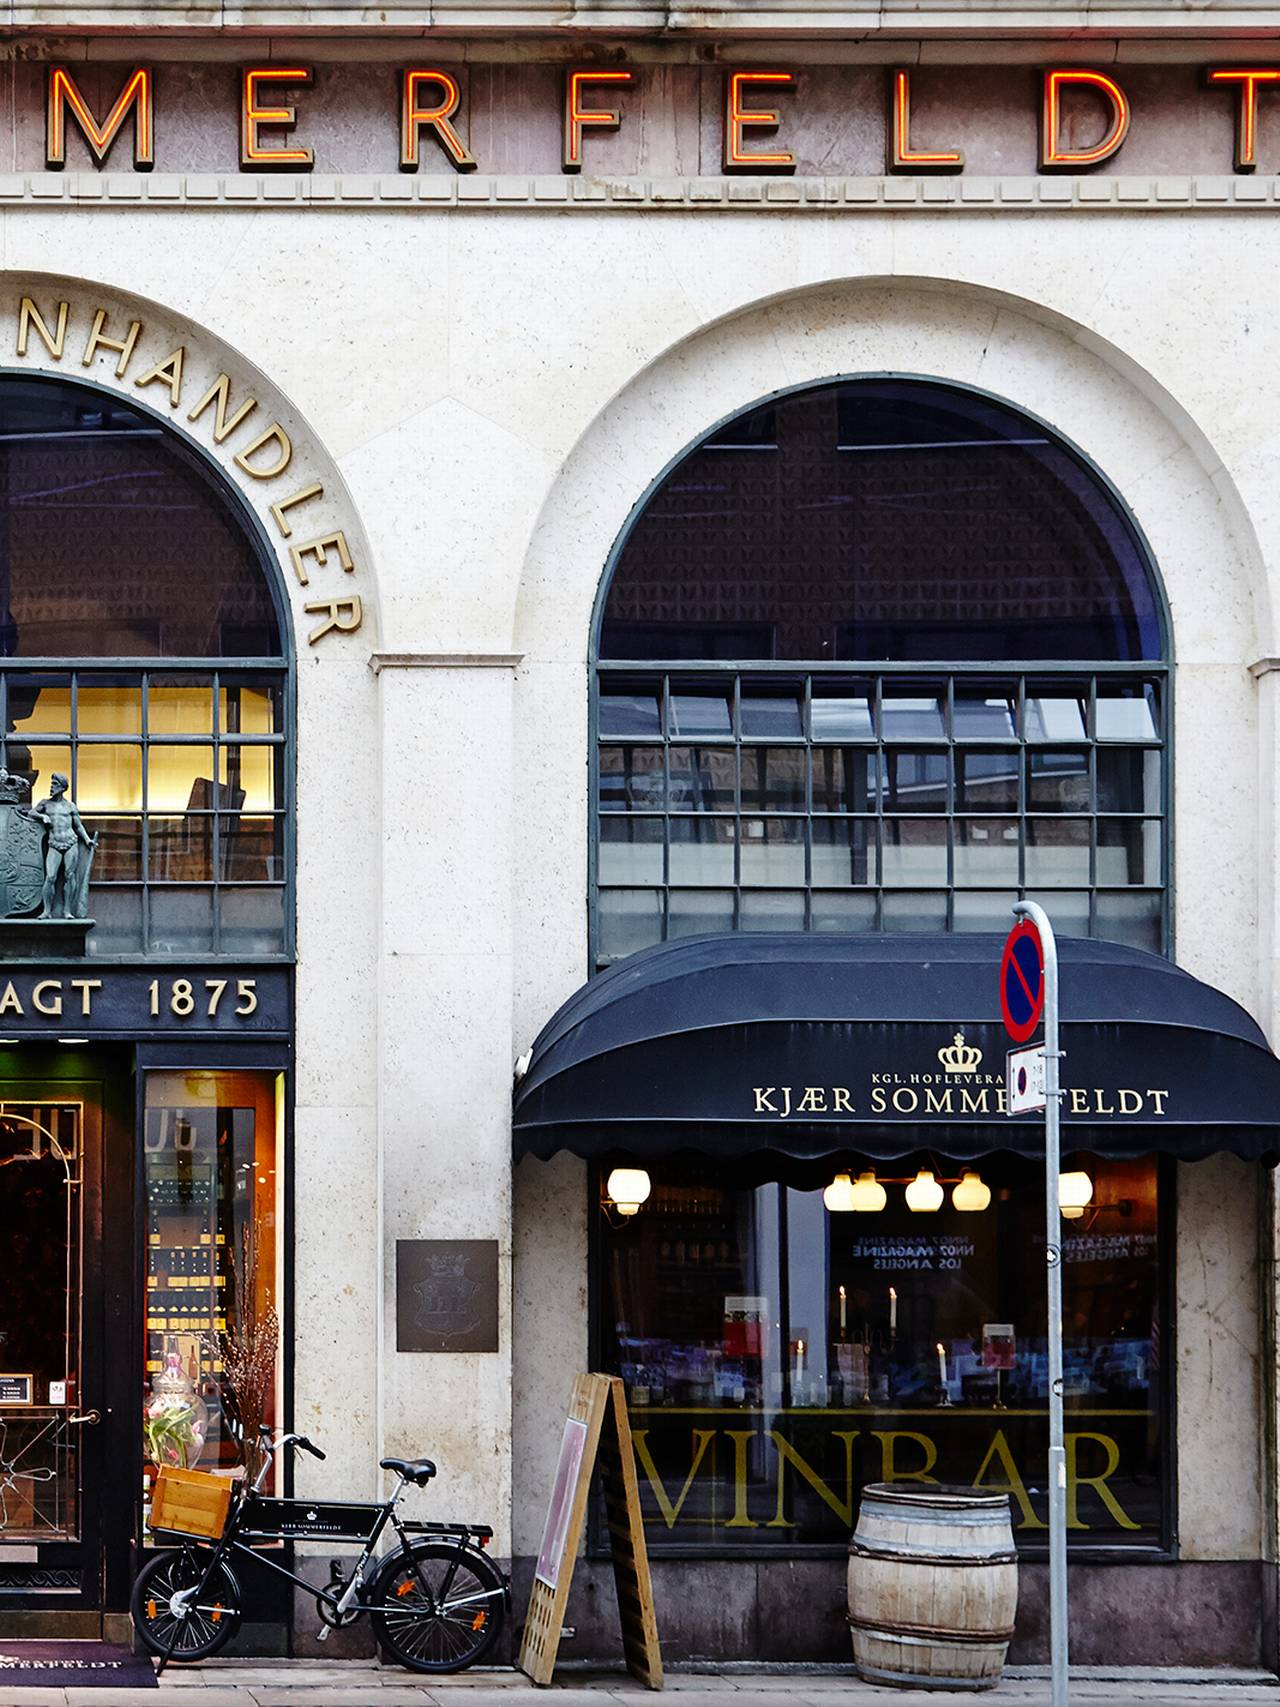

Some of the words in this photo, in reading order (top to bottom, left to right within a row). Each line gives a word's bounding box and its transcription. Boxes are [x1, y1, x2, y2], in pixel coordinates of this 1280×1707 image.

[147, 978, 259, 1016] 1875
[752, 1087, 856, 1118] KJÆR
[870, 1087, 1170, 1115] SOMMEELDT
